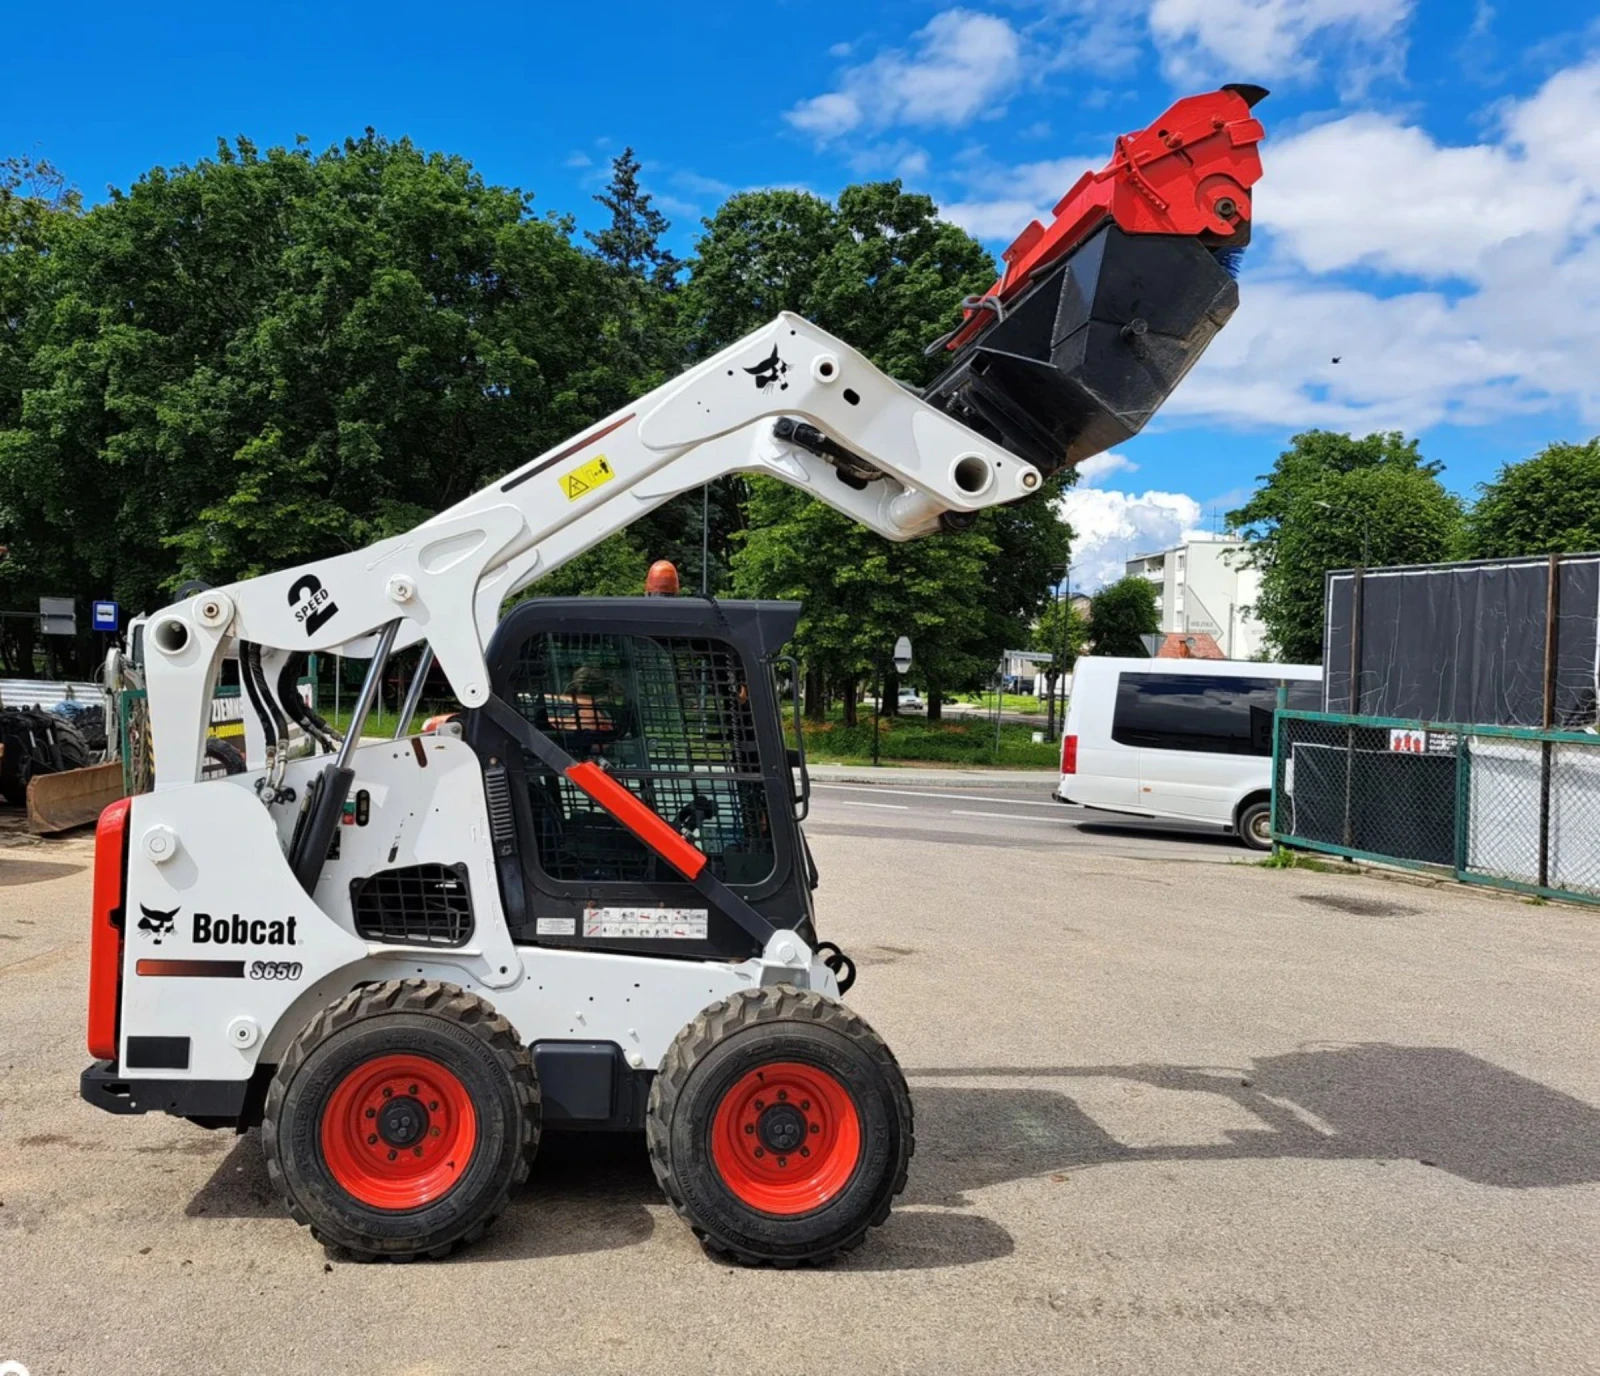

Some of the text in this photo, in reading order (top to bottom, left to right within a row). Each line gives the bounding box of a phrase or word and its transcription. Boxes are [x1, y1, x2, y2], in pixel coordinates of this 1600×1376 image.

[287, 573, 339, 637] 2
[294, 588, 329, 622] SPEED
[192, 913, 297, 945] Bobcat
[250, 960, 303, 980] S650
